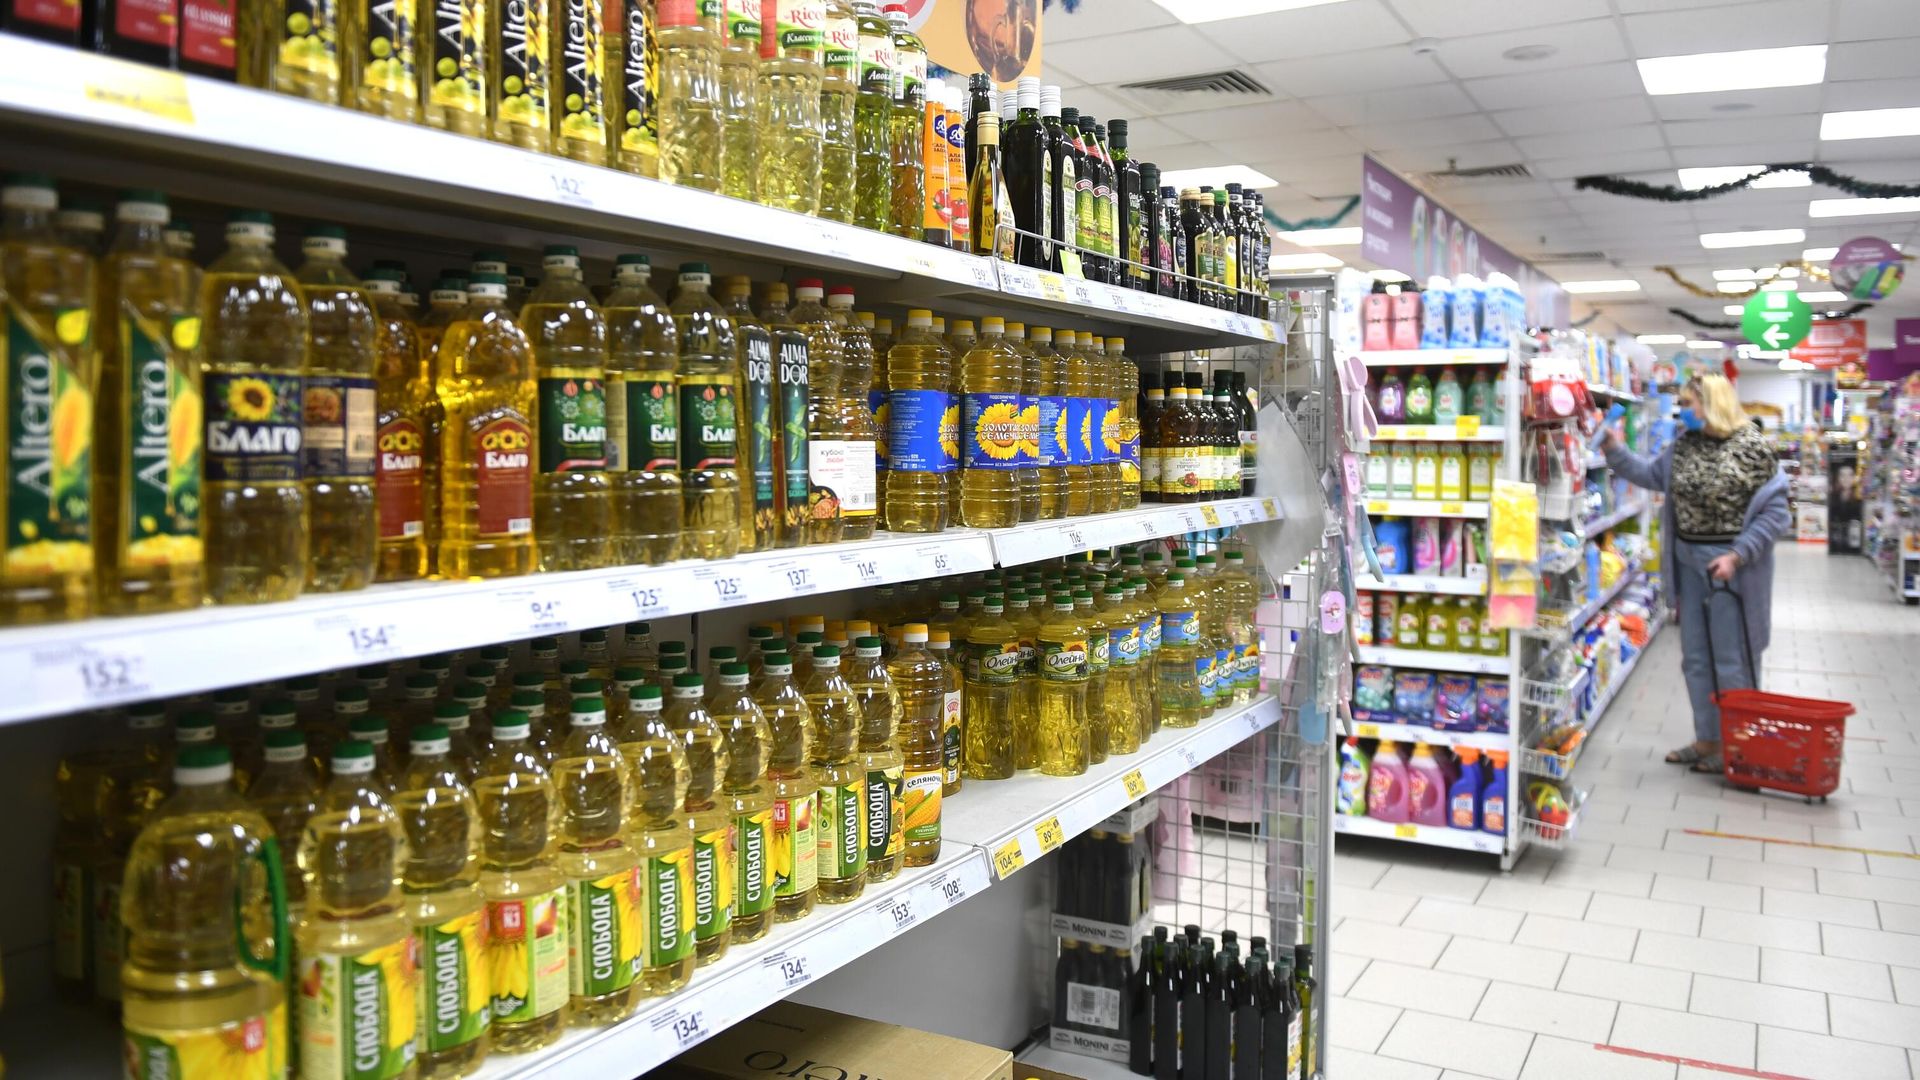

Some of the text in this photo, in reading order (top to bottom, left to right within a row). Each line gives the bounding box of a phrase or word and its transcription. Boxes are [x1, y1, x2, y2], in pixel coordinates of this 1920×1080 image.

[625, 10, 646, 105] Altero
[551, 175, 581, 196] 142
[971, 267, 987, 281] 139
[779, 344, 809, 364] ALMA
[781, 364, 809, 385] DOR
[11, 354, 54, 498] Altero
[133, 359, 171, 495] Altero
[1069, 531, 1081, 544] 116
[857, 562, 875, 577] 114
[934, 555, 946, 568] 65
[713, 578, 738, 596] 125
[787, 569, 806, 586] 137
[632, 589, 659, 608] 125
[348, 624, 389, 650] 154
[1047, 652, 1085, 667] Олейна
[79, 662, 130, 688] 152
[1127, 781, 1137, 793] 109
[869, 782, 884, 847] СЛОБОДА
[844, 796, 857, 864] СЛОБОДА
[1043, 830, 1053, 843] 89
[746, 828, 761, 902] СЛОБОДА
[999, 856, 1013, 870] 104
[696, 847, 713, 925] СЛОБОДА
[942, 880, 959, 899] 108
[659, 867, 677, 951] СЛОБОДА
[891, 903, 908, 922] 153
[591, 893, 613, 980] СЛОБОДА
[1072, 923, 1107, 938] MONINI
[780, 959, 803, 980] 134
[435, 937, 460, 1034] СЛОБОДА
[354, 969, 380, 1072] СЛОБОДА
[673, 1014, 699, 1041] 134
[1073, 1037, 1109, 1050] MONINI
